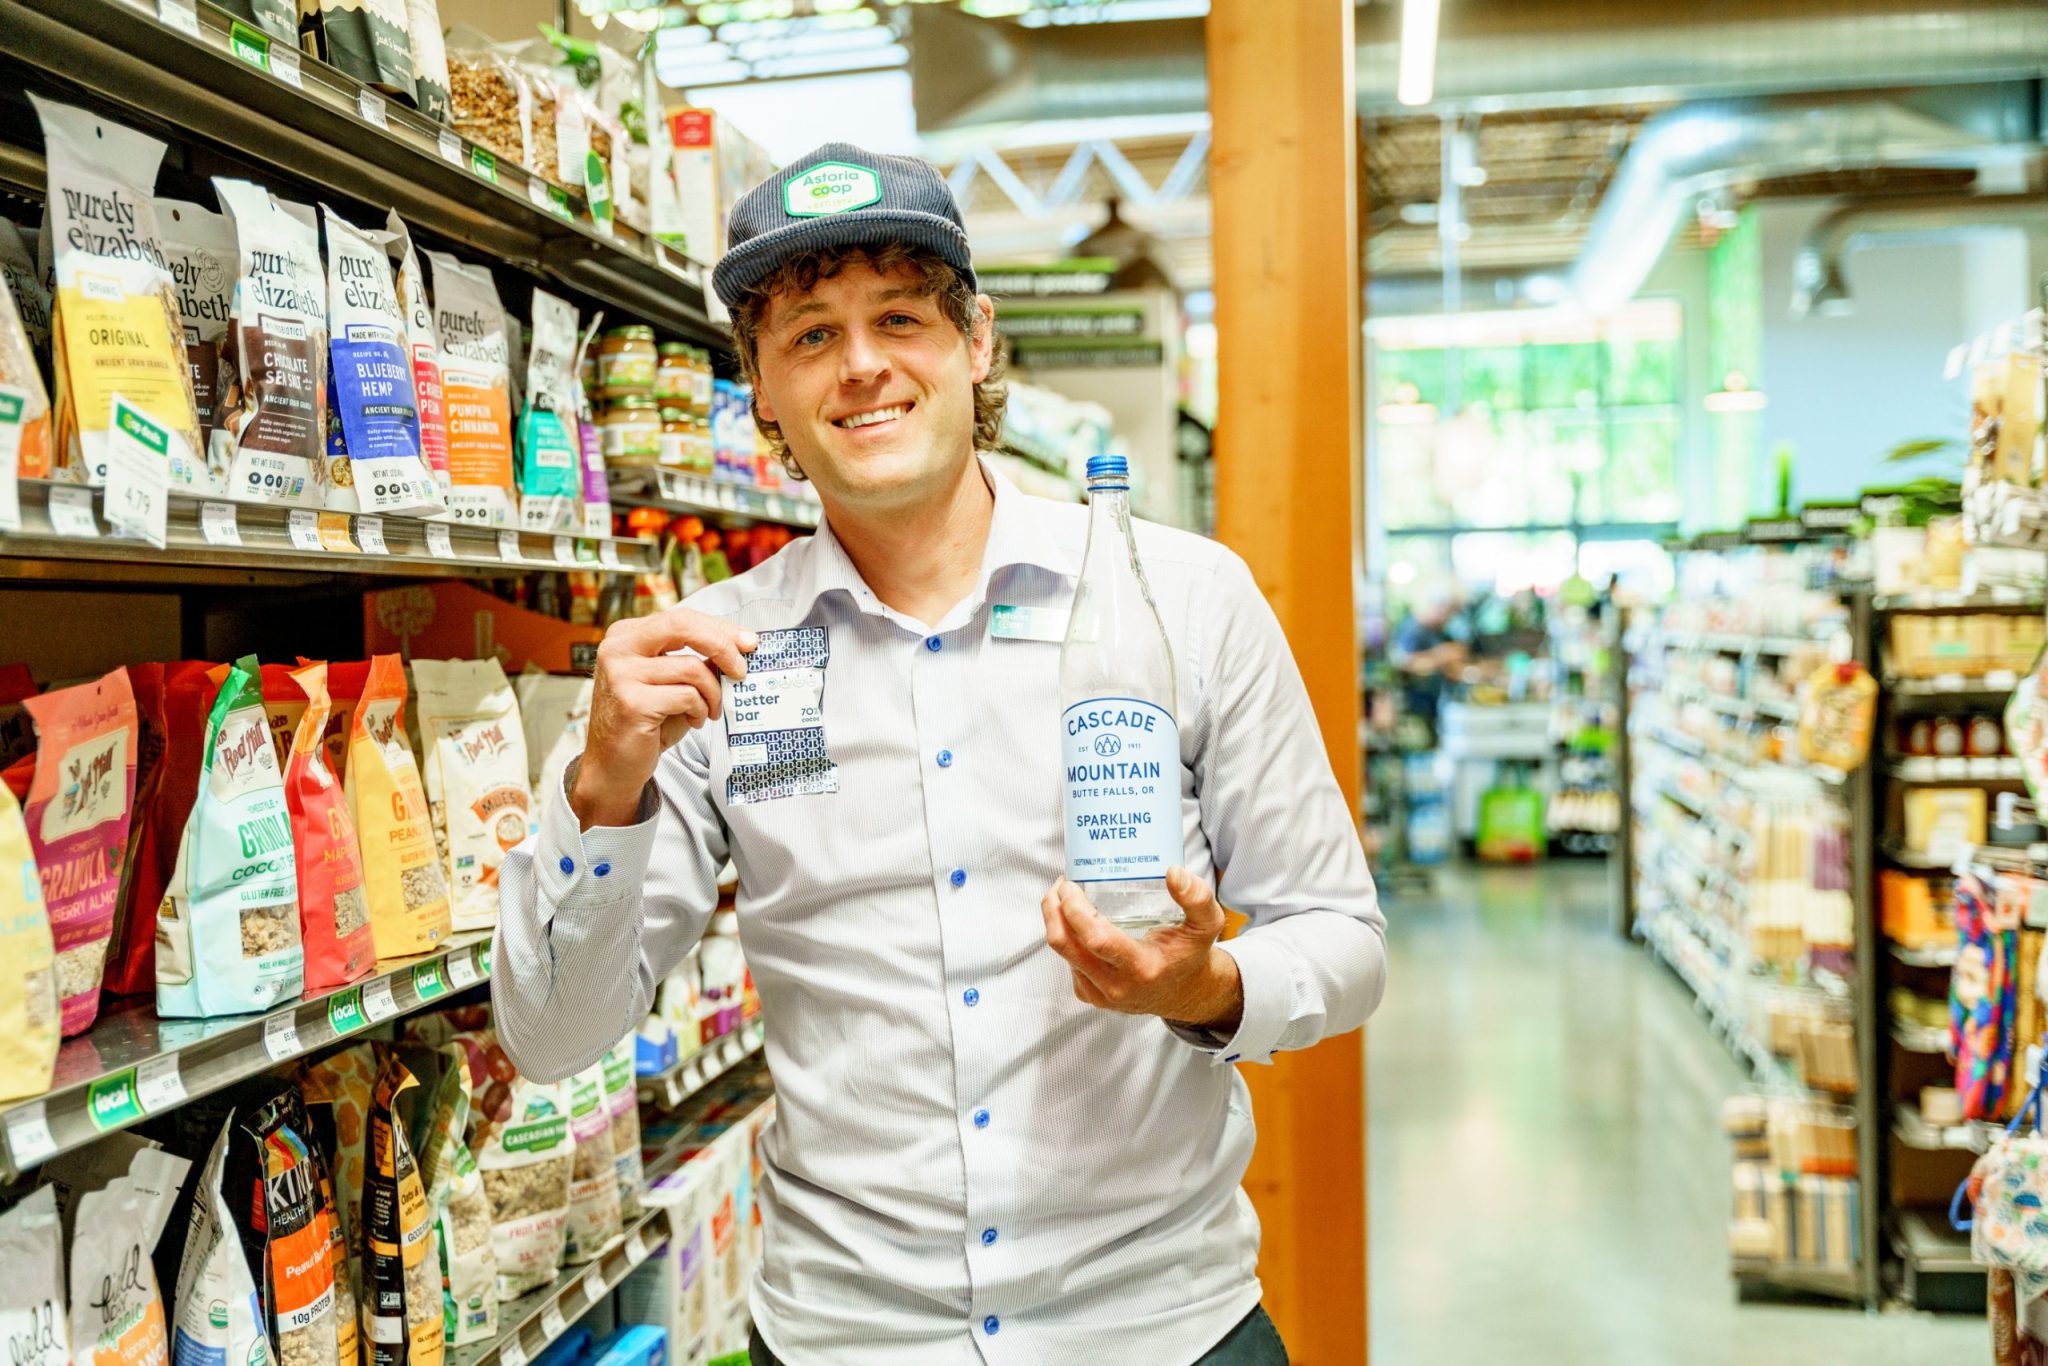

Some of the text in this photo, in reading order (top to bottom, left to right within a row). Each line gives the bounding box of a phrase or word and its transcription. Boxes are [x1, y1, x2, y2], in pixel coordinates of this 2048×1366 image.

[803, 170, 859, 187] Astoria
[62, 187, 134, 233] purely
[89, 328, 150, 348] ORIGINAL
[351, 331, 366, 339] MADE
[95, 358, 125, 368] ANCIENT
[266, 370, 287, 387] SEA
[356, 362, 407, 383] BLUEBERRY
[361, 381, 393, 397] HEMP
[263, 394, 289, 406] ANCIENT
[365, 405, 390, 415] ANCIENT
[448, 403, 491, 420] PUMPKIN
[450, 420, 499, 436] CINNAMON
[733, 681, 757, 694] the
[734, 694, 780, 708] better
[735, 709, 760, 723] bar
[1067, 709, 1157, 736] CASCADE
[222, 720, 267, 781] Red Mill
[1067, 761, 1160, 783] MOUNTAIN
[1072, 785, 1154, 799] BUTTE FALLS, OR
[482, 790, 521, 815] MUES
[1076, 811, 1152, 828] SPARKLING
[1089, 827, 1138, 841] WATER
[40, 847, 107, 904] GRANOLA
[240, 886, 285, 901] GLUTEN FREE
[51, 903, 87, 925] BERRY
[89, 888, 118, 909] ALMO
[417, 968, 438, 989] local
[333, 998, 357, 1022] local
[95, 1082, 131, 1114] local
[505, 1126, 555, 1147] CASCADIAN
[267, 1156, 314, 1213] KIND
[286, 1260, 313, 1278] Peanut
[291, 1312, 310, 1327] 10g
